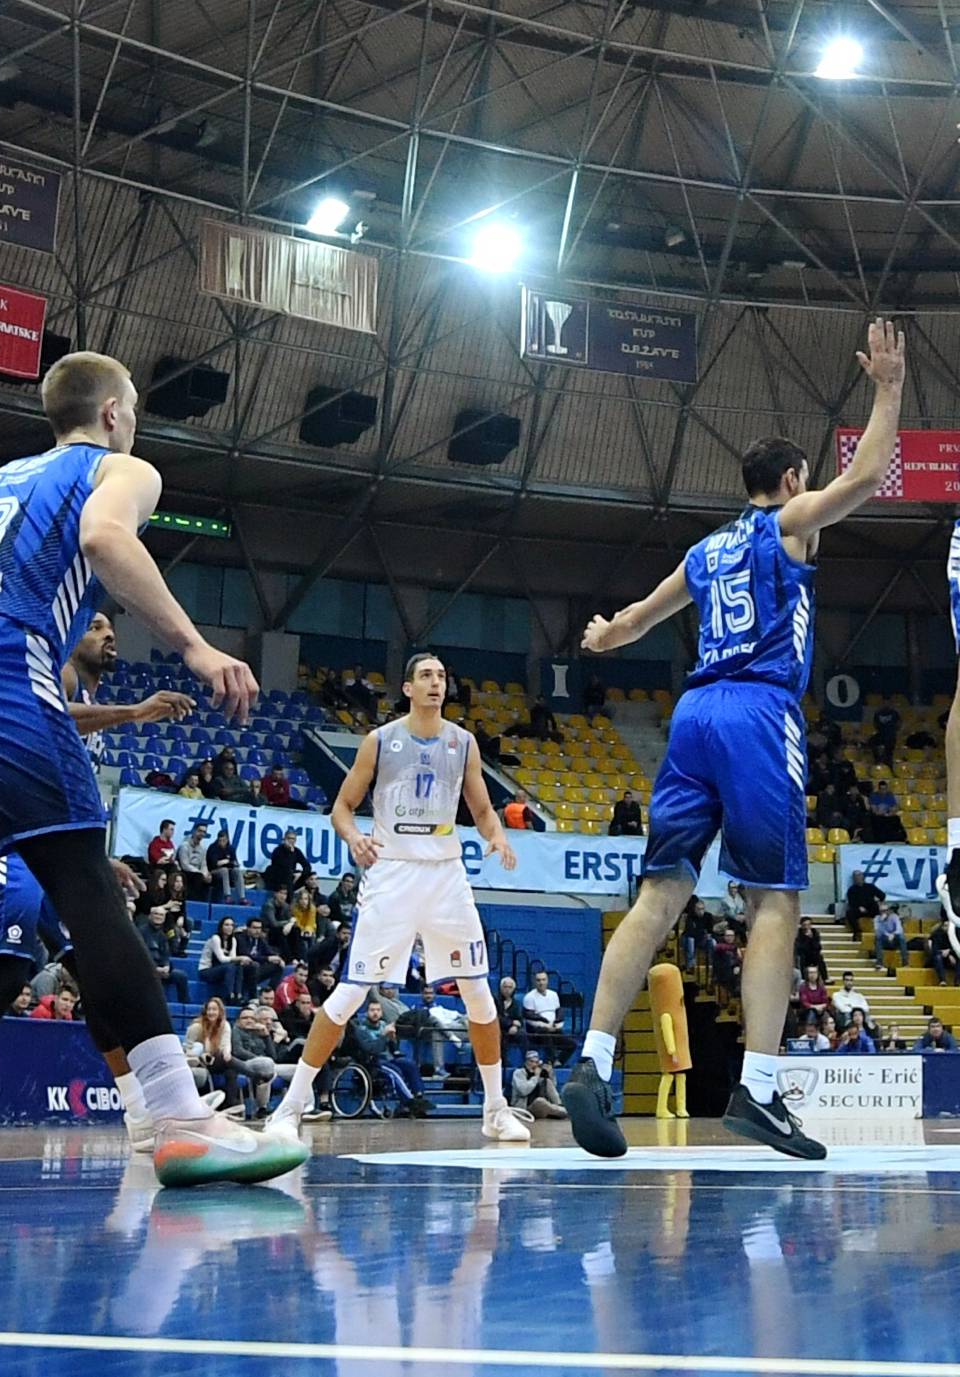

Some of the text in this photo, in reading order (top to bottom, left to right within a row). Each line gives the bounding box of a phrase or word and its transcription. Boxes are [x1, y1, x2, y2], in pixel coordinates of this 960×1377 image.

[632, 328, 656, 338] KUP
[711, 570, 755, 639] 15
[415, 773, 435, 798] 17
[565, 850, 646, 881] ERST
[469, 940, 483, 966] 17
[824, 1066, 863, 1084] Bilić
[881, 1066, 918, 1084] Erić
[47, 1086, 126, 1111] KK CIBO
[819, 1095, 920, 1108] SECURITY
